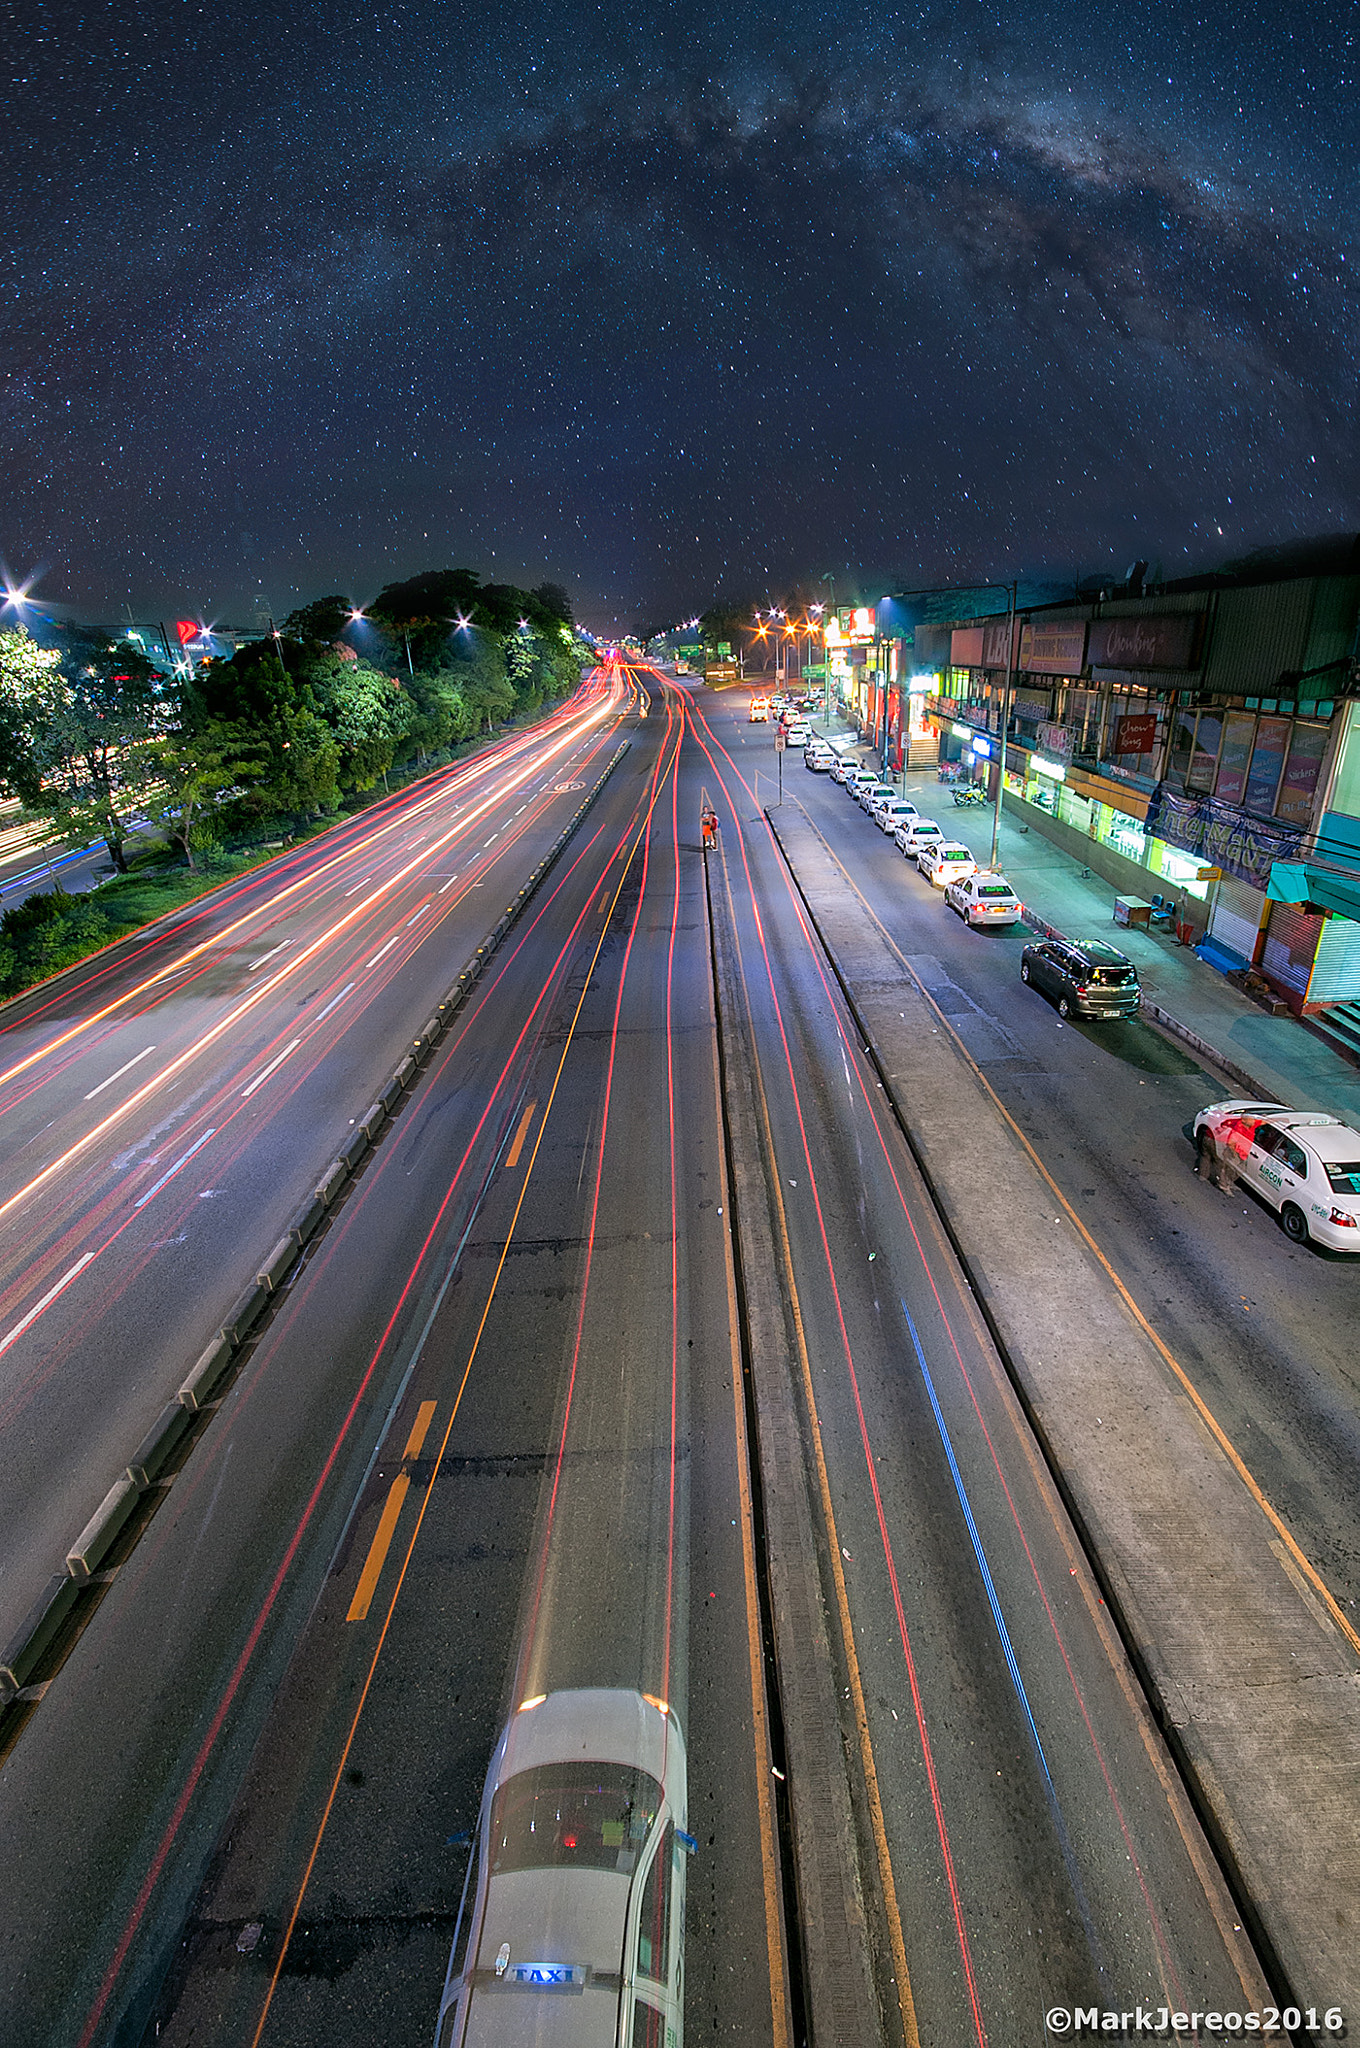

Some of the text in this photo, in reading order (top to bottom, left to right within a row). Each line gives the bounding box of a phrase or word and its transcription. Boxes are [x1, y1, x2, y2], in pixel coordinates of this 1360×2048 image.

[1288, 768, 1317, 781] Stickers
[1259, 1165, 1283, 1187] AIRCON
[512, 1968, 573, 1982] TAXI
